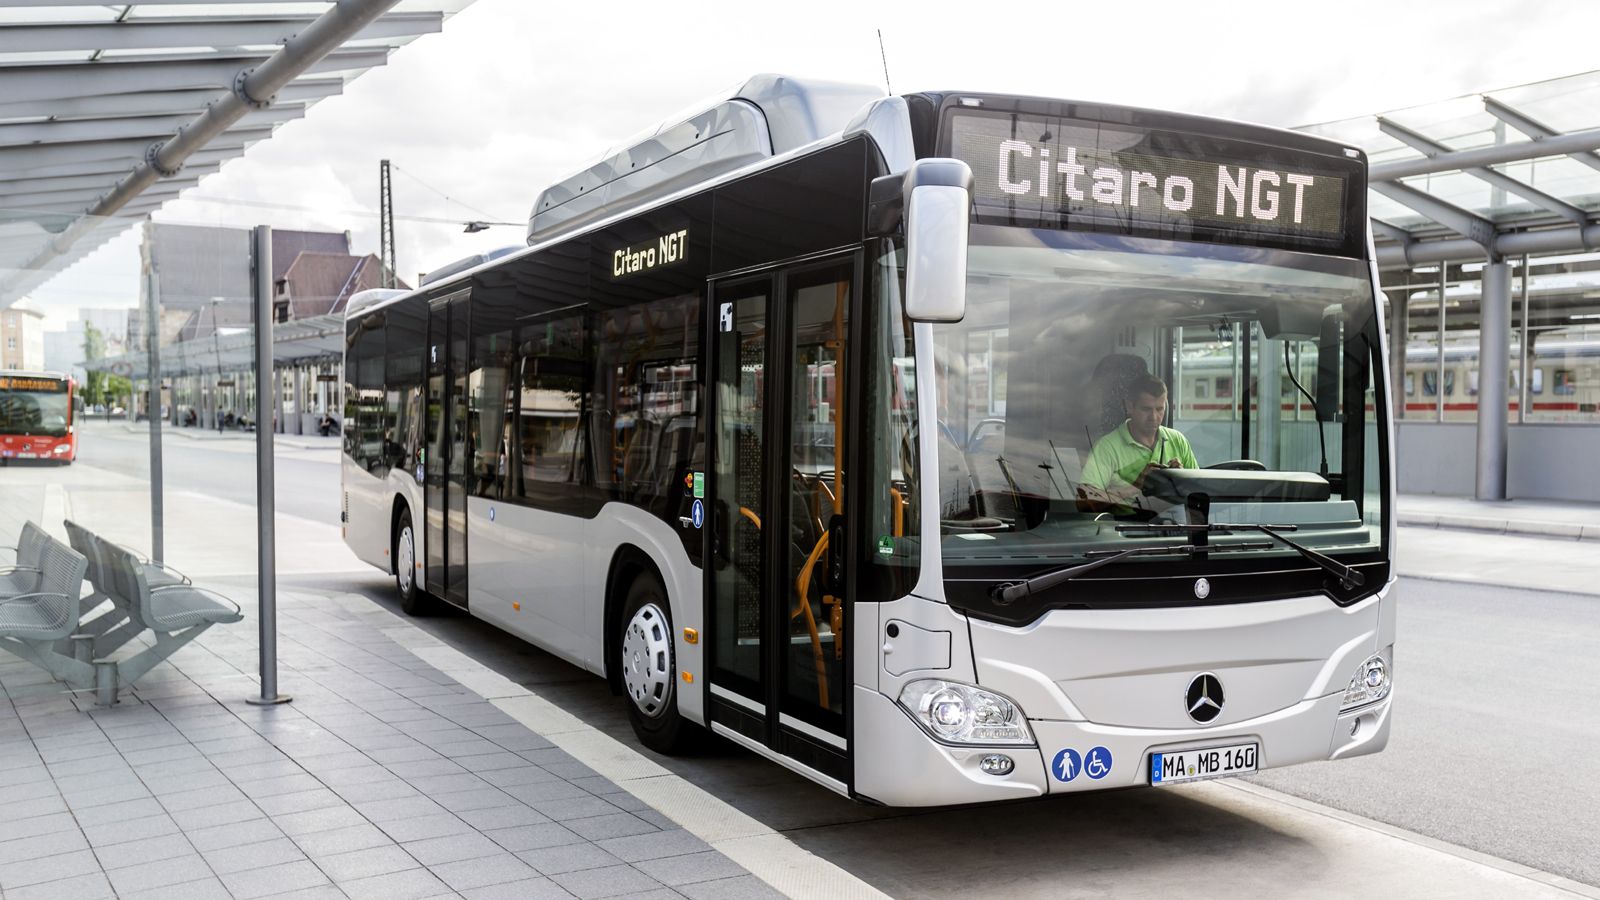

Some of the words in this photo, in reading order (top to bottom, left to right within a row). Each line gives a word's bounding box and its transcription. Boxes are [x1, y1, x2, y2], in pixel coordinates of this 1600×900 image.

[998, 139, 1195, 212] Citaro
[1216, 165, 1315, 224] NGT
[614, 247, 655, 277] Citaro
[659, 230, 687, 264] NGT
[883, 536, 889, 546] 4
[1163, 755, 1185, 777] MA
[1198, 752, 1219, 774] MB
[1224, 748, 1254, 770] 160
